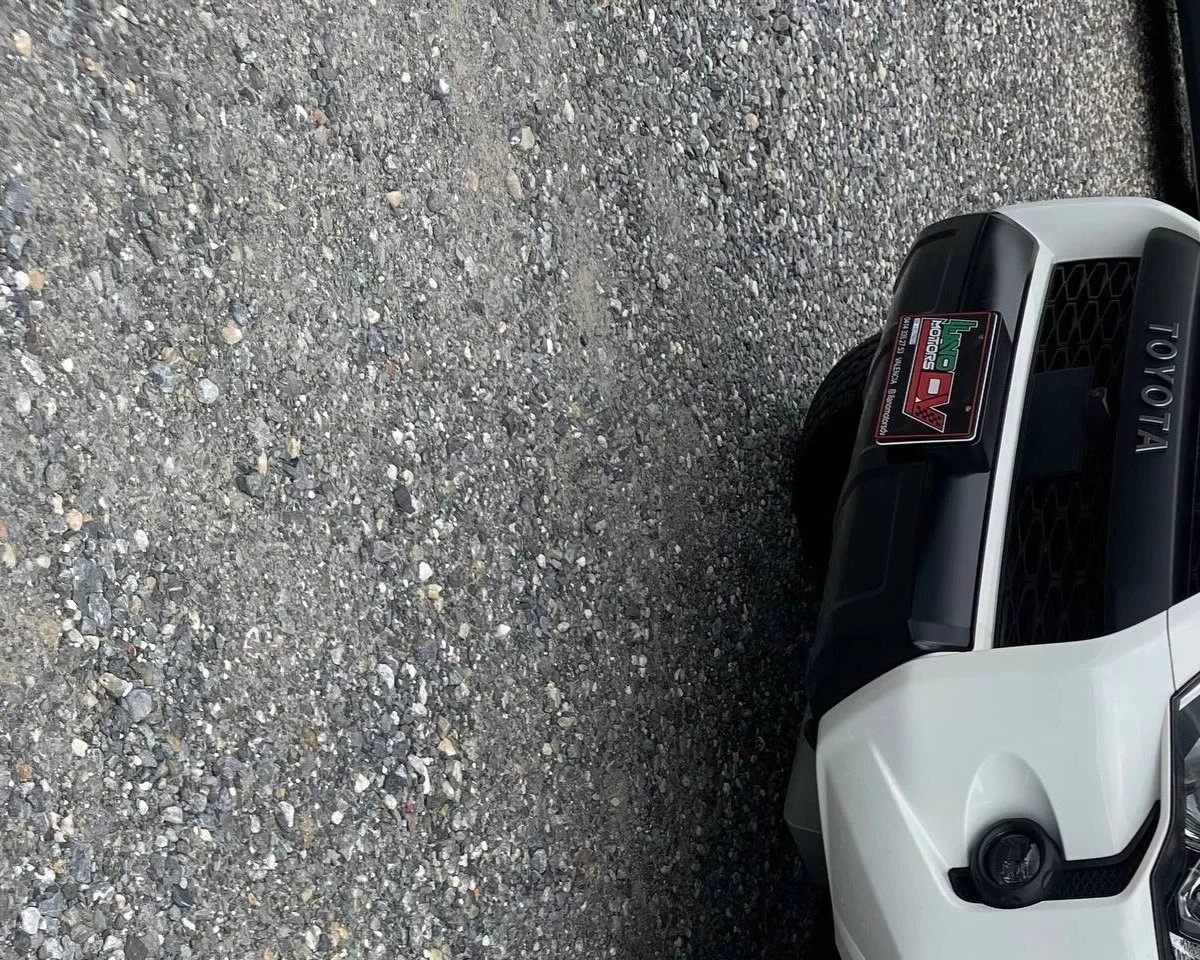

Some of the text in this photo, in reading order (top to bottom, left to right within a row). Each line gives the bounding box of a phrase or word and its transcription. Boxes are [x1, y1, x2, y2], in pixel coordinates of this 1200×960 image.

[922, 320, 943, 370] MOTORS
[889, 357, 902, 385] VALENCIA
[1135, 322, 1180, 453] TOYOTA
